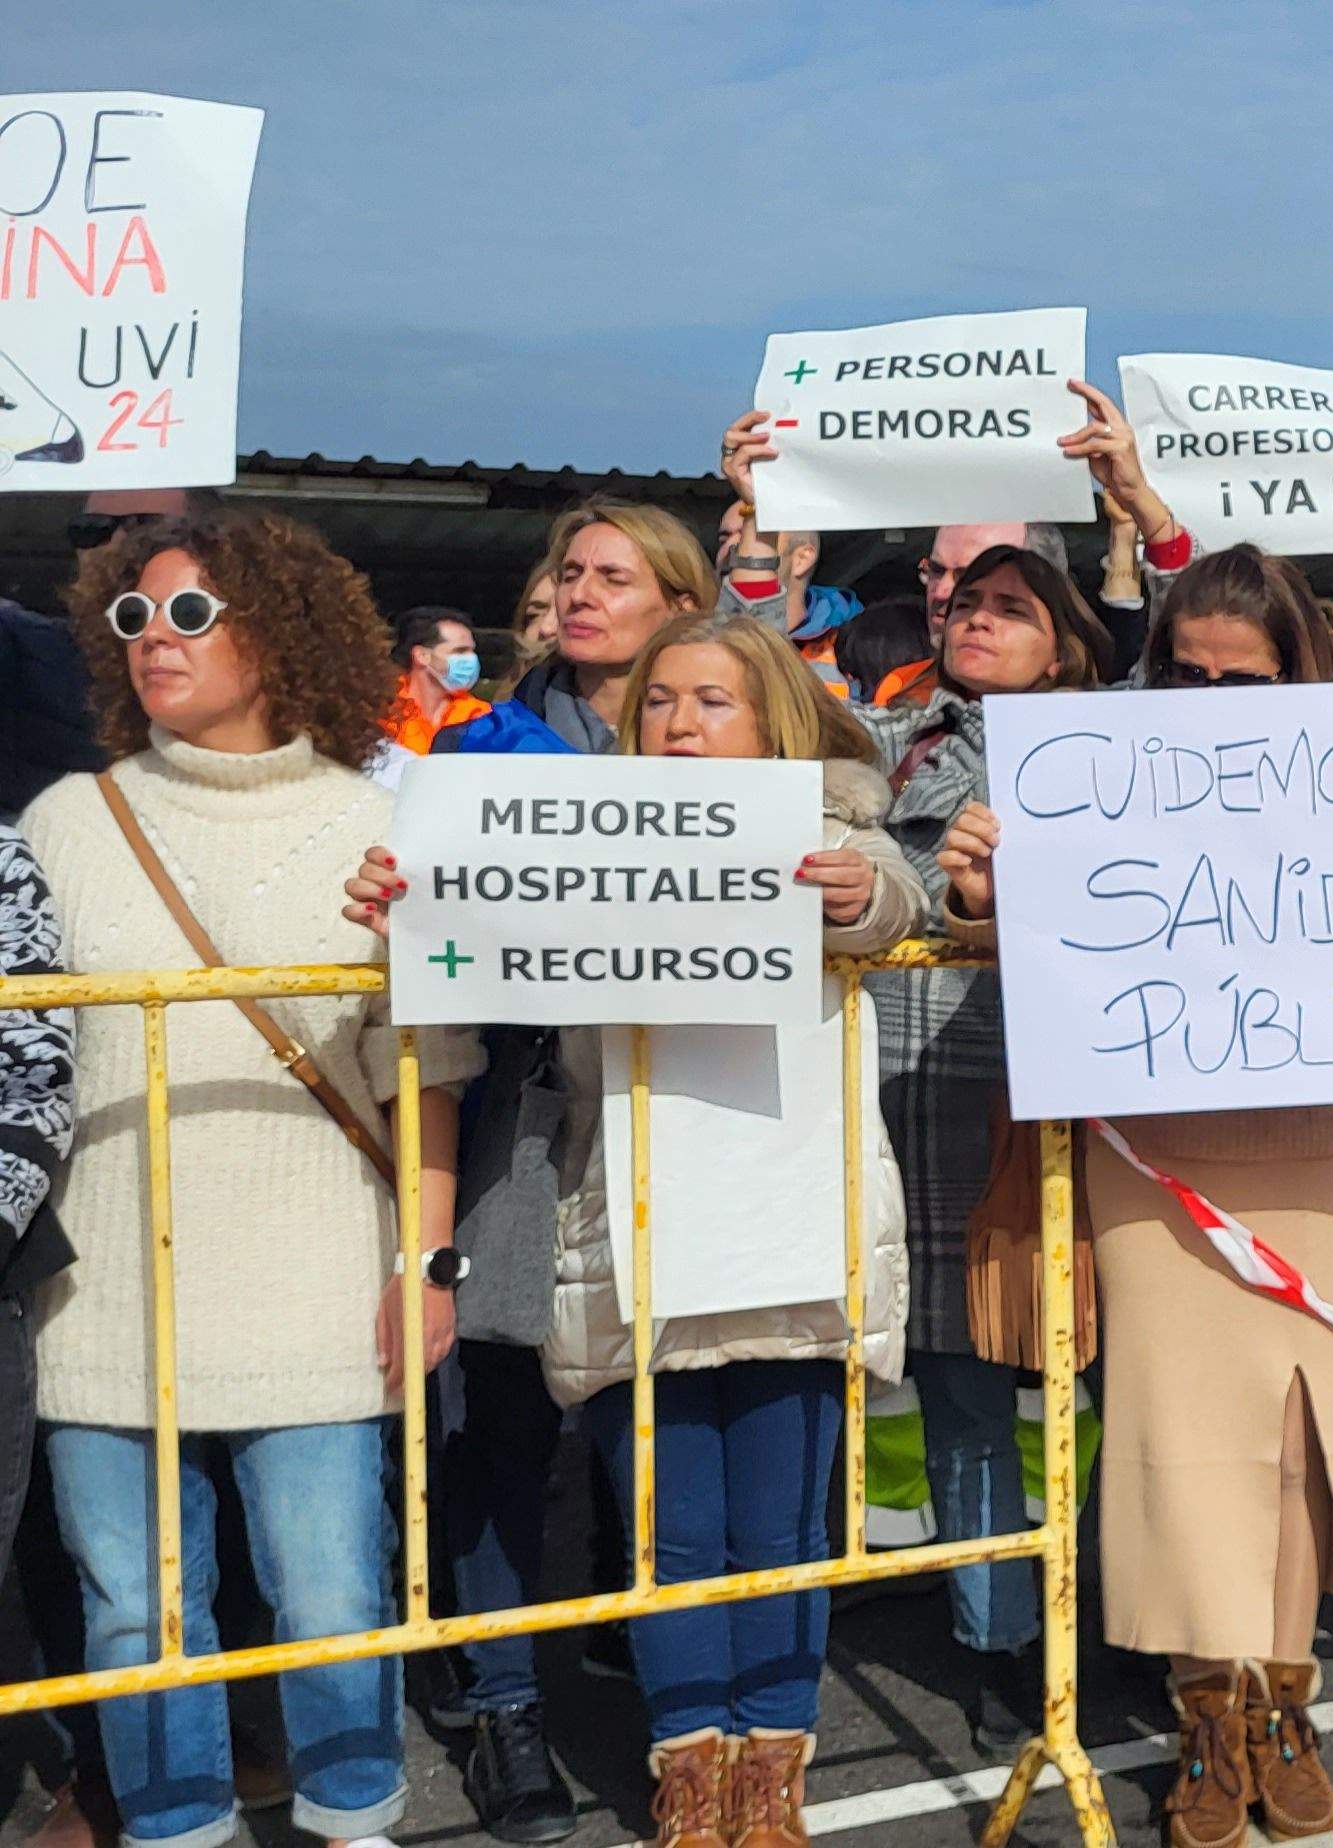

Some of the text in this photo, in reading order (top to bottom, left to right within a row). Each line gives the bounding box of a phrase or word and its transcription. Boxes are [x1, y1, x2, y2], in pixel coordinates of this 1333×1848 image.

[78, 310, 199, 388] UVI
[834, 348, 1057, 382] PERSONAL
[97, 388, 184, 451] 24
[819, 408, 1031, 440] DEMORAS
[481, 798, 736, 838] MEJORES
[433, 865, 781, 903] HOSPITALES
[500, 946, 793, 982] RECURSOS
